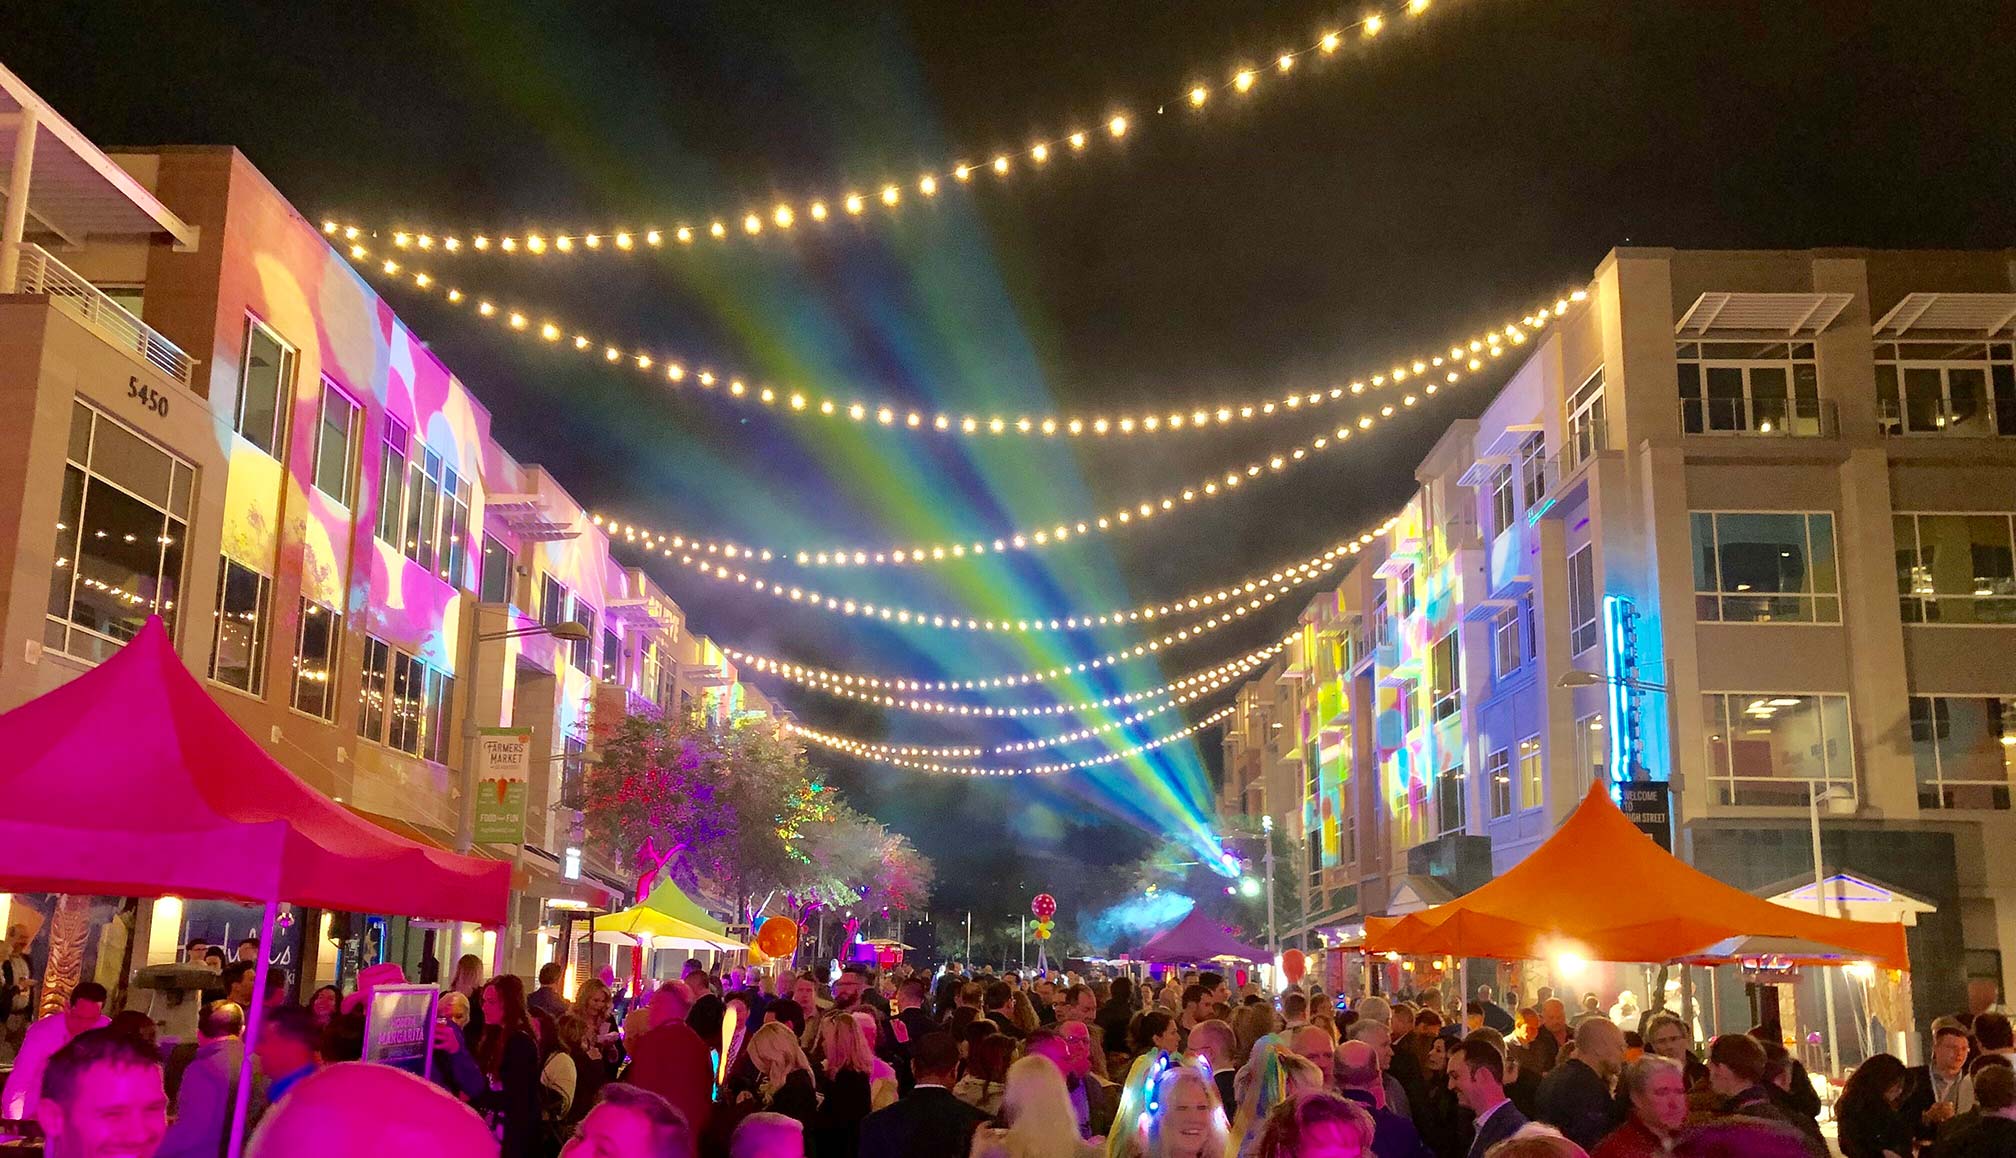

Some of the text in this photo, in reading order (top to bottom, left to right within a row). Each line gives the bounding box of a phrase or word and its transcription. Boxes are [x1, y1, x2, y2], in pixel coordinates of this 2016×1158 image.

[128, 376, 168, 417] 5450
[484, 741, 524, 754] FARMERS
[490, 753, 523, 765] MARKET
[1624, 791, 1658, 801] WELCOME
[1642, 813, 1665, 824] STREET
[378, 1026, 425, 1045] MARGARITA
